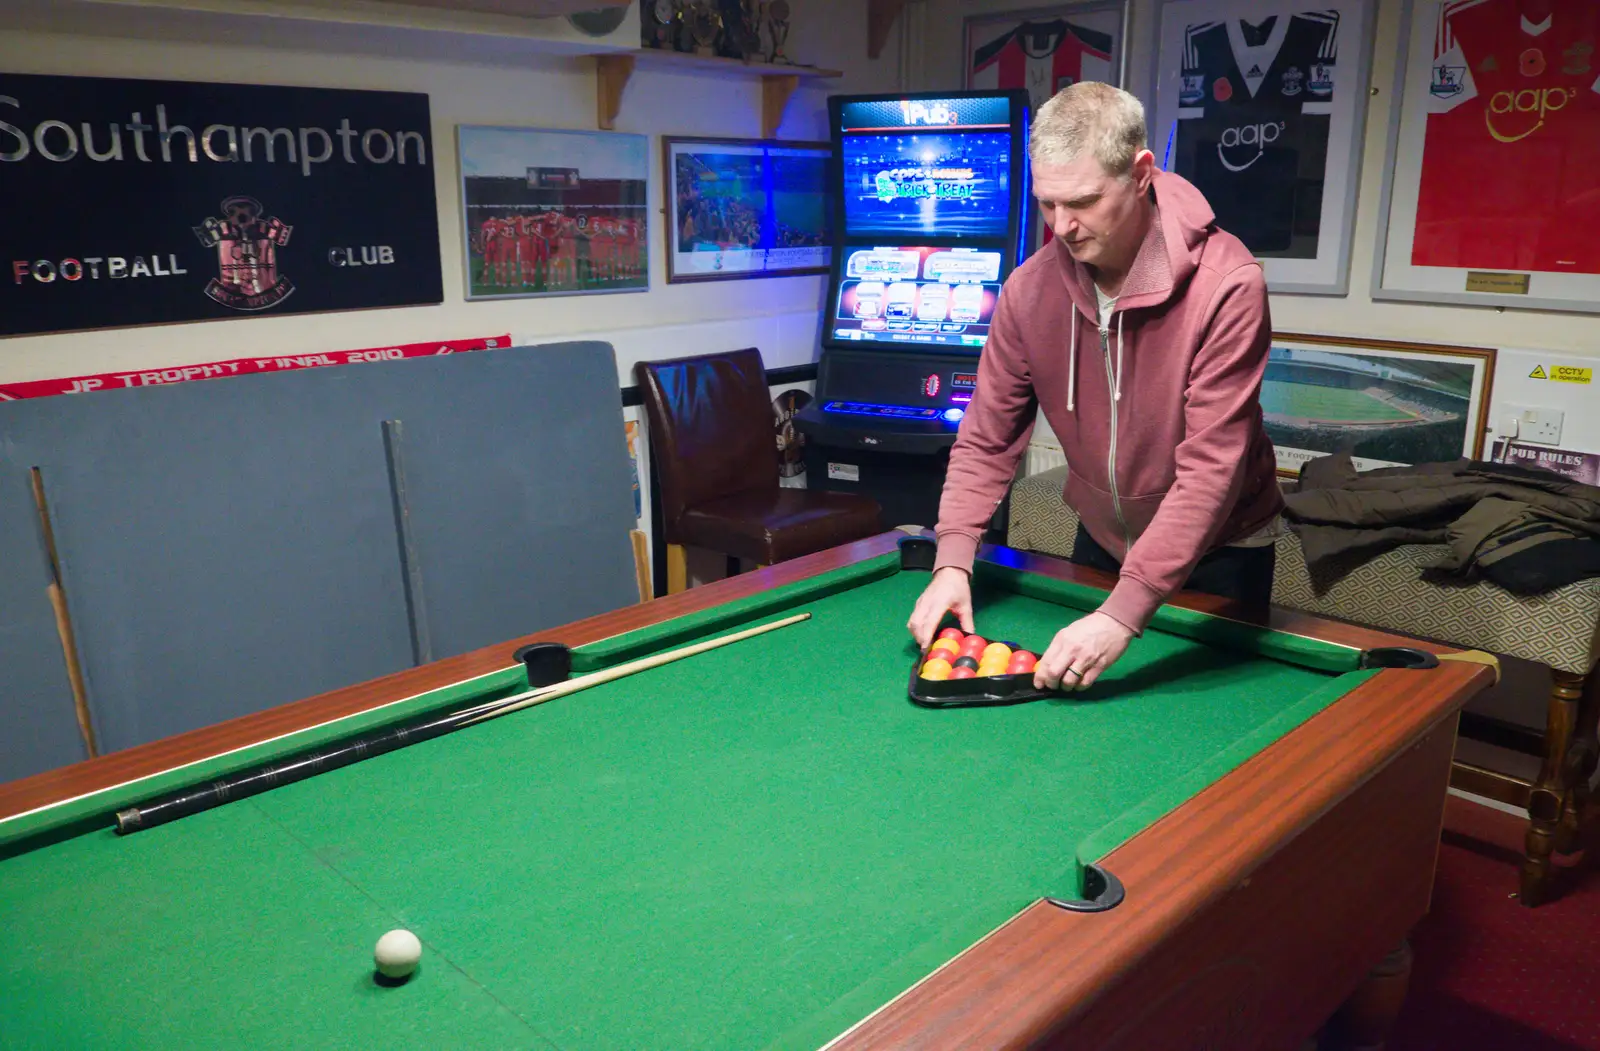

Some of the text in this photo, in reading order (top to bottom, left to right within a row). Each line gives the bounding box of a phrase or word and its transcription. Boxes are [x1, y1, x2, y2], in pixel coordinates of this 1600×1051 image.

[0, 94, 427, 176] Southampton
[935, 181, 974, 198] TREAT
[12, 245, 395, 285] FOOTBALL CLUB
[61, 349, 404, 395] JP TROPHY FINAL 2010
[1558, 366, 1585, 376] CCTV
[1558, 375, 1592, 384] operation
[1509, 447, 1537, 461] PUB
[1539, 451, 1583, 466] RULES
